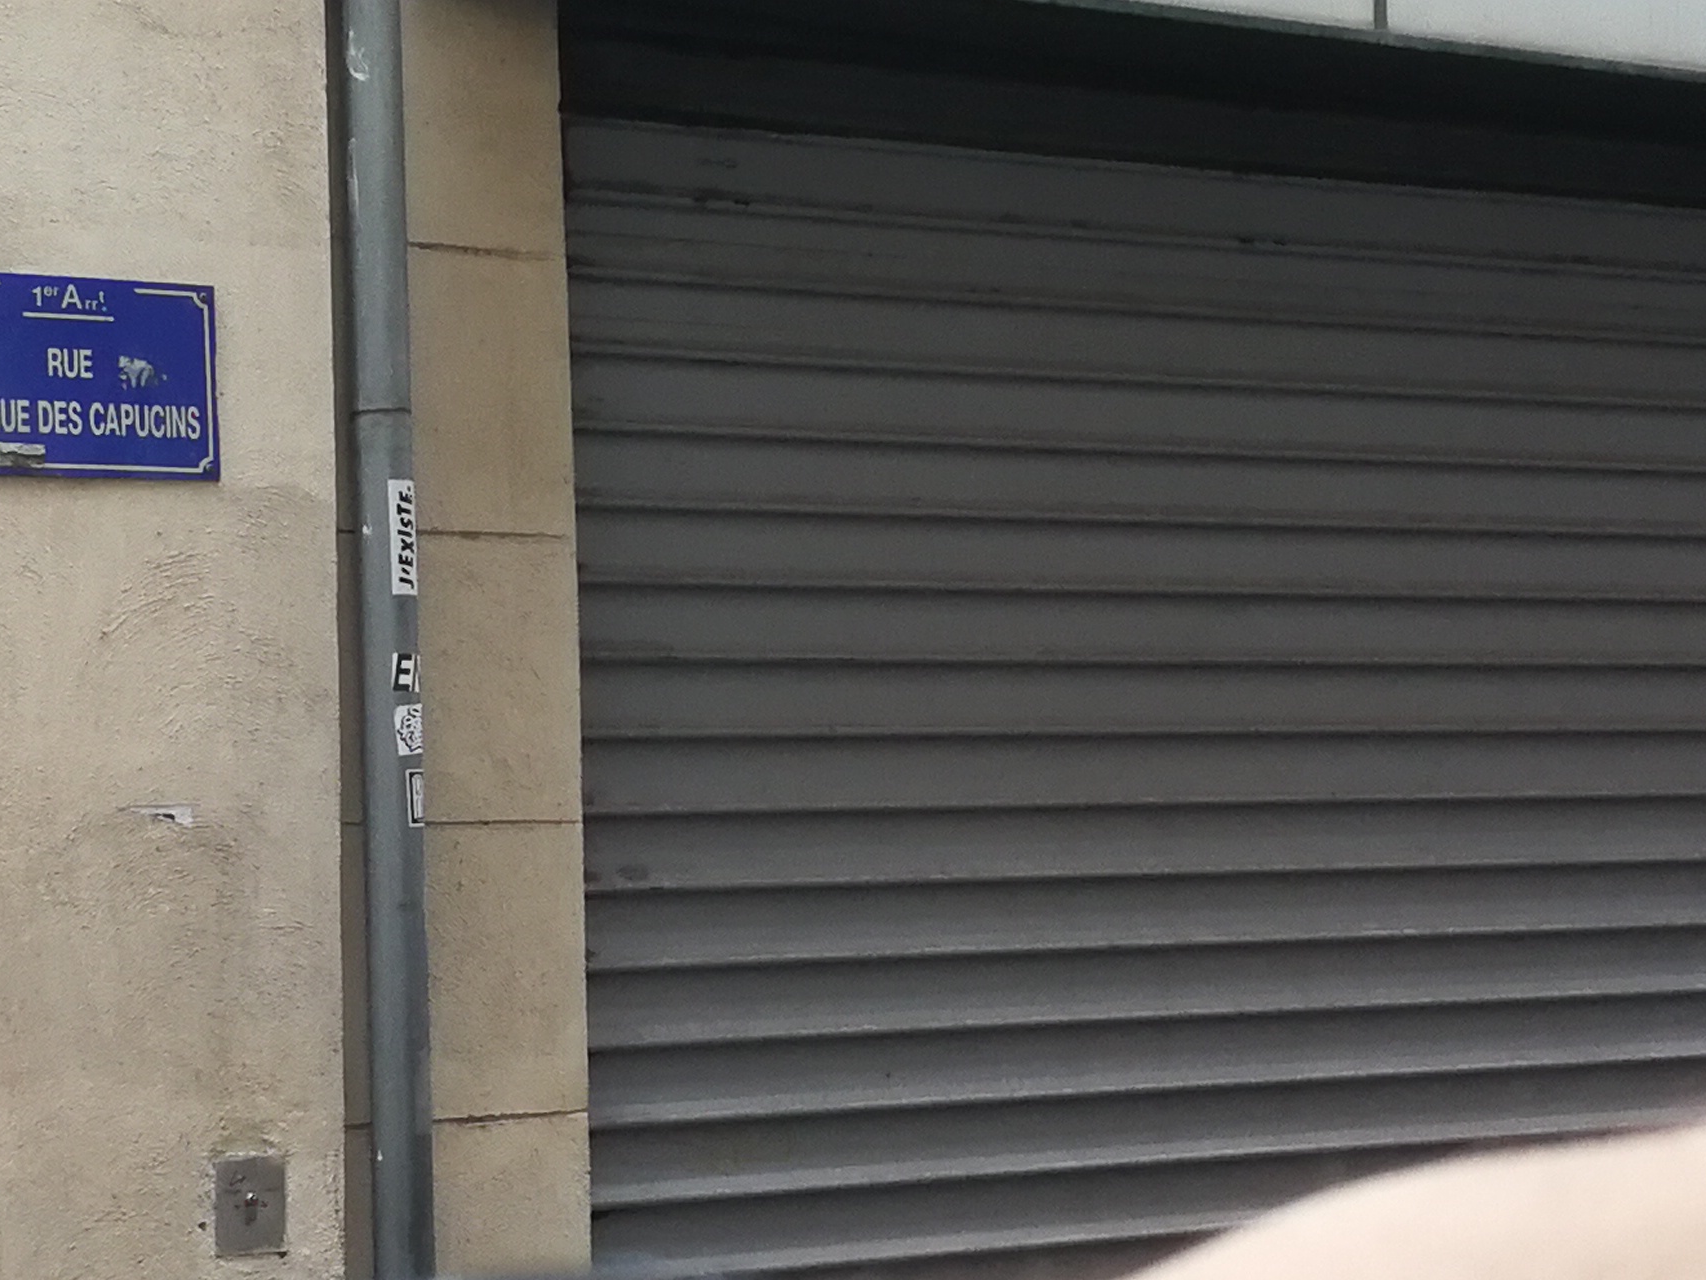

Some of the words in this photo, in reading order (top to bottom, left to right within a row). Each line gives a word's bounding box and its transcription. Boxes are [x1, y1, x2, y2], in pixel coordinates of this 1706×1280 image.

[46, 347, 93, 379] RUE
[37, 400, 83, 436] DES
[89, 402, 201, 440] CAPUCINS
